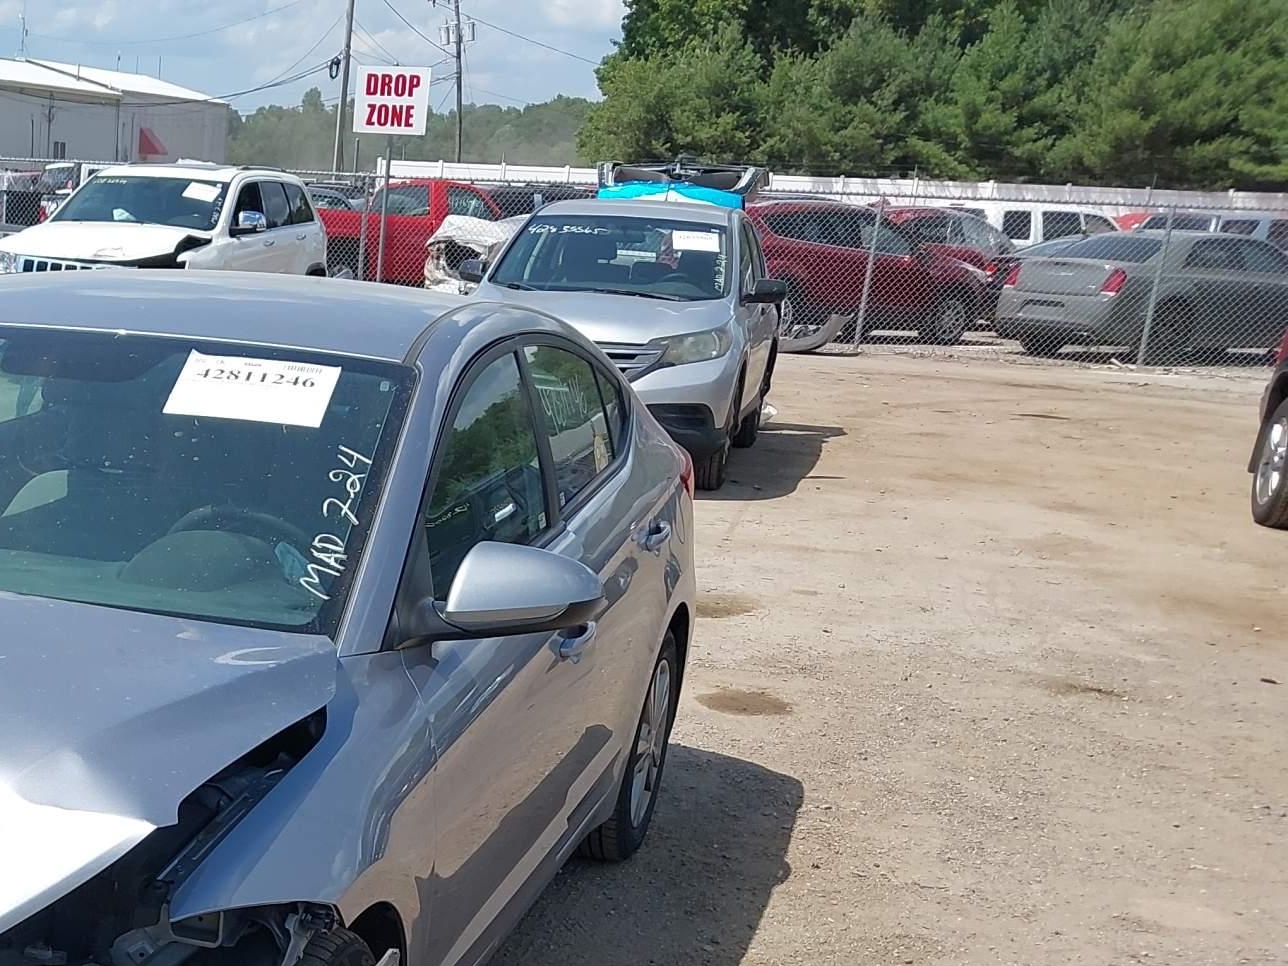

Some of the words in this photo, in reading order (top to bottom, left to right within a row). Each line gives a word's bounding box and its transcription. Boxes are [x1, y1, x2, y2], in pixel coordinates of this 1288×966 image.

[365, 73, 421, 97] DROP
[365, 103, 415, 127] ZONE
[196, 368, 315, 388] 42811246
[299, 533, 348, 600] MAD
